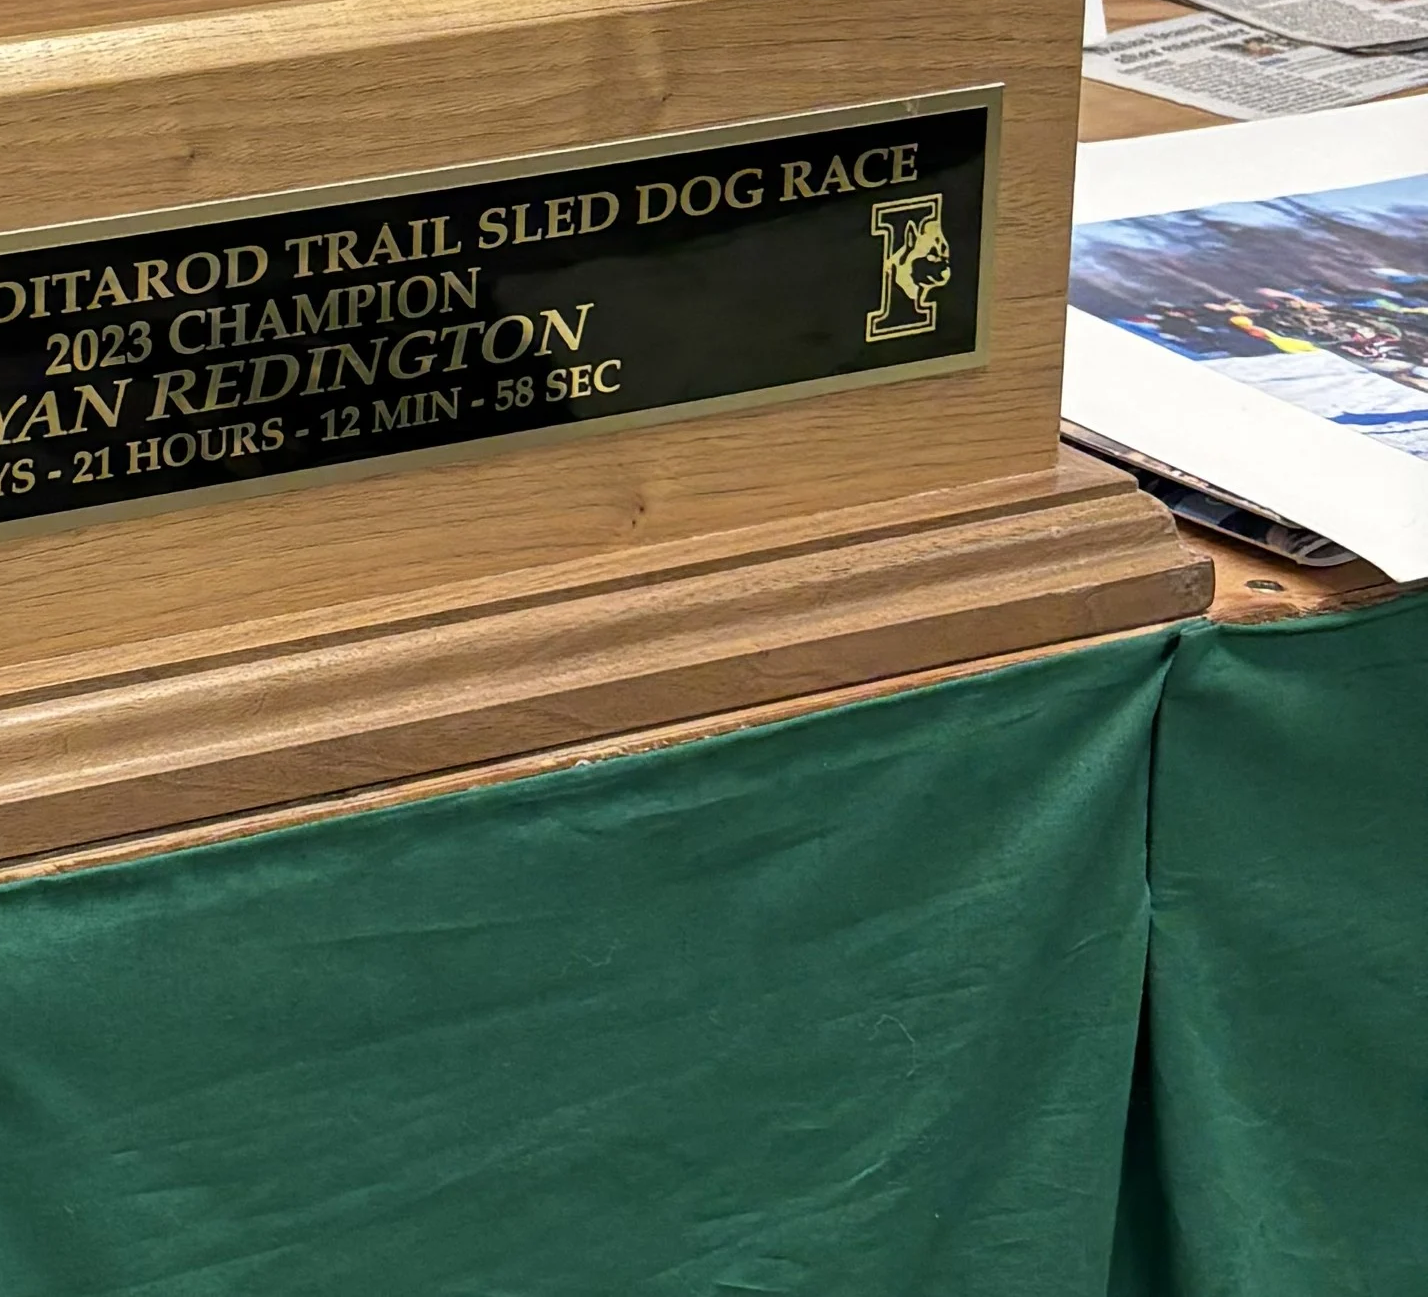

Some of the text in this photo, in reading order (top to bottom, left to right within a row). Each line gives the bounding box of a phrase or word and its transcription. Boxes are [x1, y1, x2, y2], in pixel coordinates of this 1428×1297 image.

[286, 217, 462, 278] TRAIL
[478, 191, 620, 253] SLED
[636, 169, 764, 226] DOG
[780, 143, 919, 204] RACE
[46, 267, 481, 376] 2023 CHAMPION
[145, 302, 594, 423] REDINGTON
[73, 449, 111, 483] 21
[126, 417, 286, 475] HOURS
[320, 404, 361, 442] 12
[371, 385, 460, 434] MIN
[495, 378, 535, 413] 58
[545, 359, 623, 402] SEC
